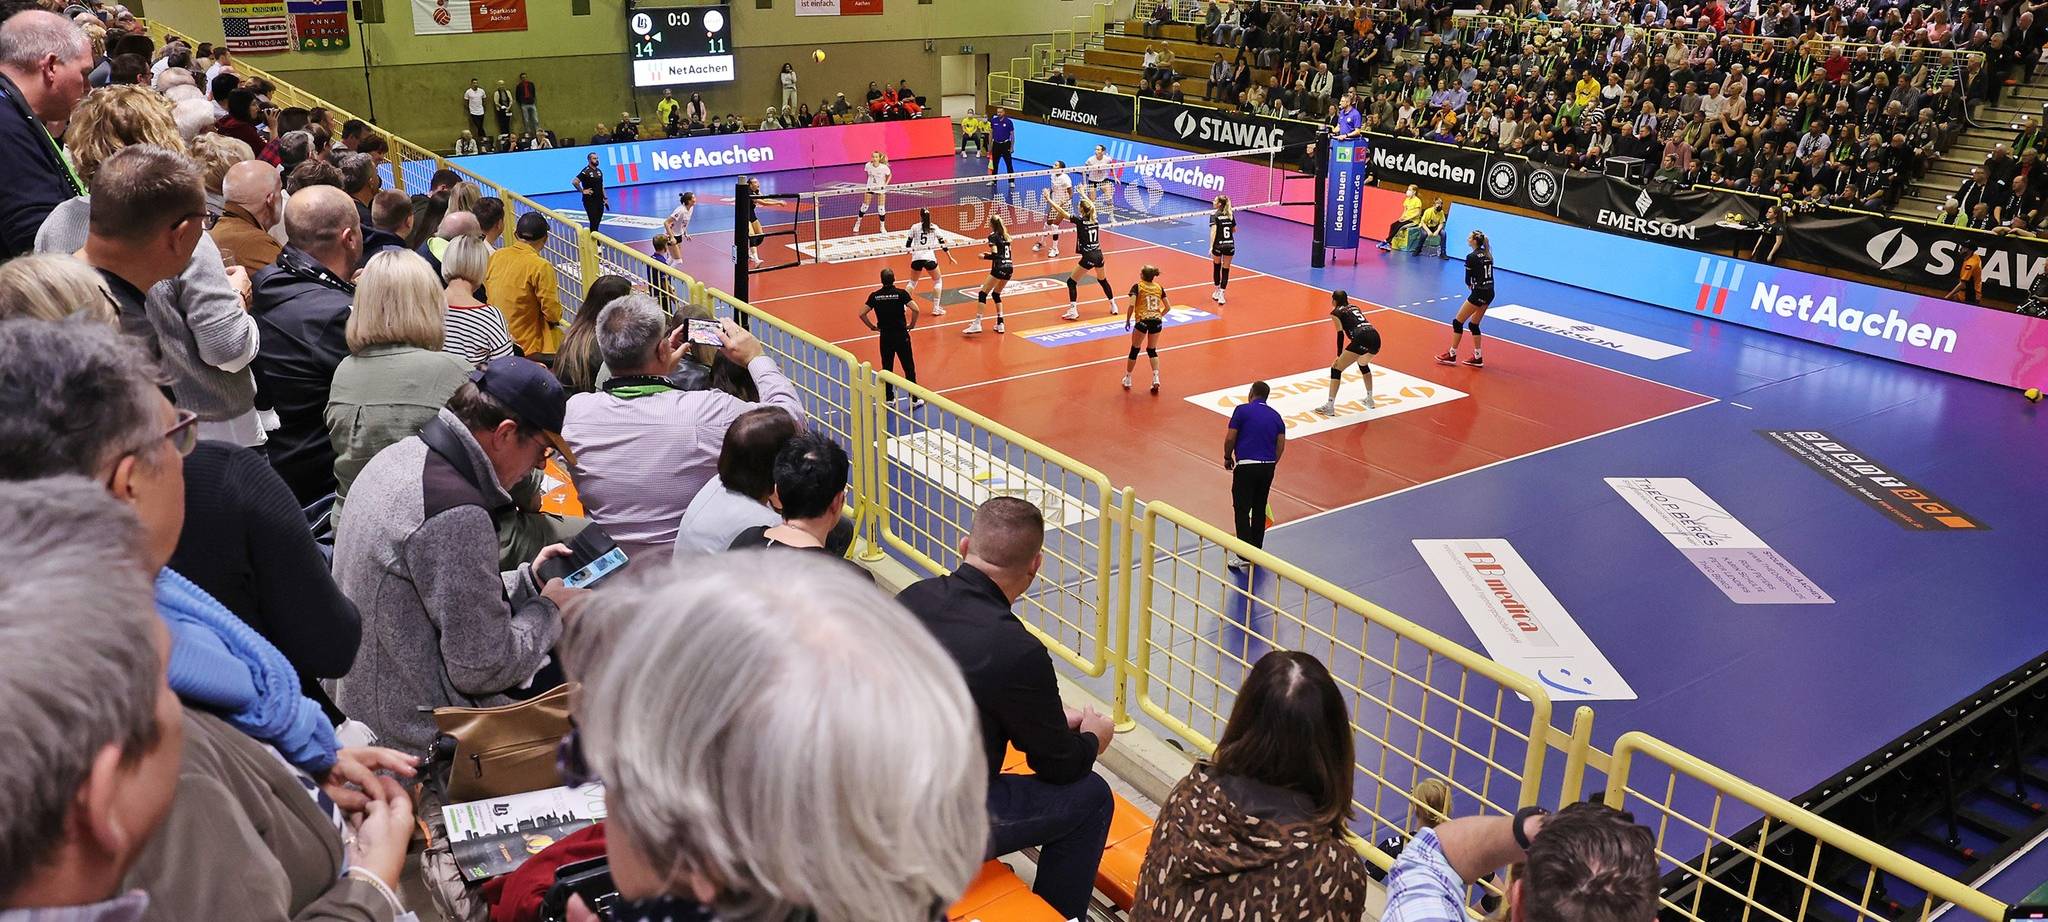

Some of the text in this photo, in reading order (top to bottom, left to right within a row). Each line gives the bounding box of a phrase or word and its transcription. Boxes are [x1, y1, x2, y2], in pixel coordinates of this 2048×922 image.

[668, 12, 690, 26] 0:0
[636, 42, 654, 58] 14
[708, 38, 726, 53] 11
[668, 64, 728, 75] NetAachen
[1051, 107, 1098, 125] EMERSON
[1200, 116, 1285, 150] STAWAG
[652, 144, 774, 172] NetAachen
[1372, 146, 1476, 186] NetAachen
[1134, 154, 1225, 192] NetAachen
[1334, 171, 1347, 231] ideen bauen
[1088, 230, 1098, 242] 17
[1597, 208, 1696, 240] EMERSON
[920, 232, 928, 246] 5
[1484, 264, 1492, 280] 14
[1146, 295, 1160, 310] 13
[1750, 280, 1958, 354] NetAachen
[1510, 316, 1624, 349] EMERSON
[1672, 512, 1719, 547] BERGS
[1485, 579, 1539, 632] medica
